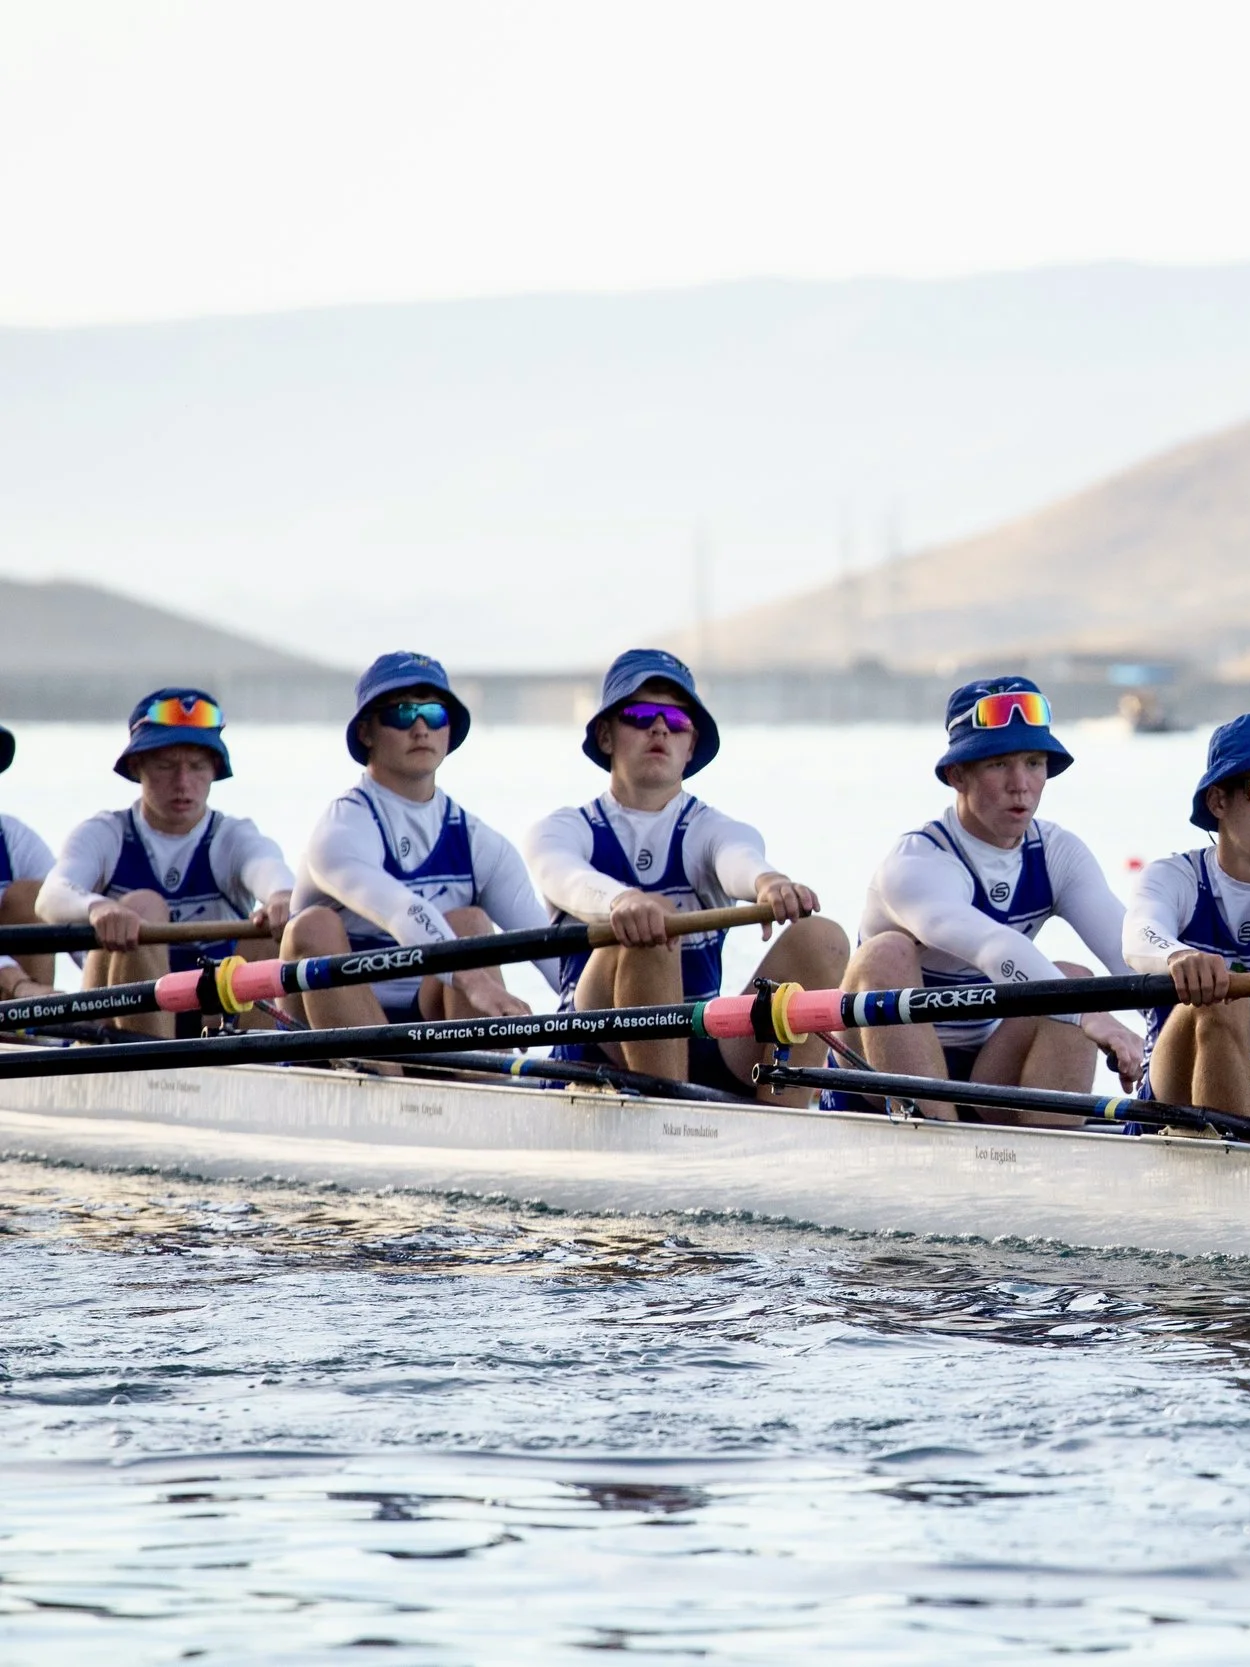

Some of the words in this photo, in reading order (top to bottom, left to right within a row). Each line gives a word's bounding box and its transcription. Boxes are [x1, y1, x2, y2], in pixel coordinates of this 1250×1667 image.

[341, 948, 424, 974] CROKER
[908, 988, 996, 1009] CROKER
[7, 1007, 31, 1020] Old
[407, 1028, 421, 1040] St
[488, 1023, 540, 1036] College
[544, 1018, 568, 1032] Old
[683, 1123, 719, 1139] Foundation
[975, 1145, 988, 1160] Leo
[990, 1147, 1017, 1165] English
